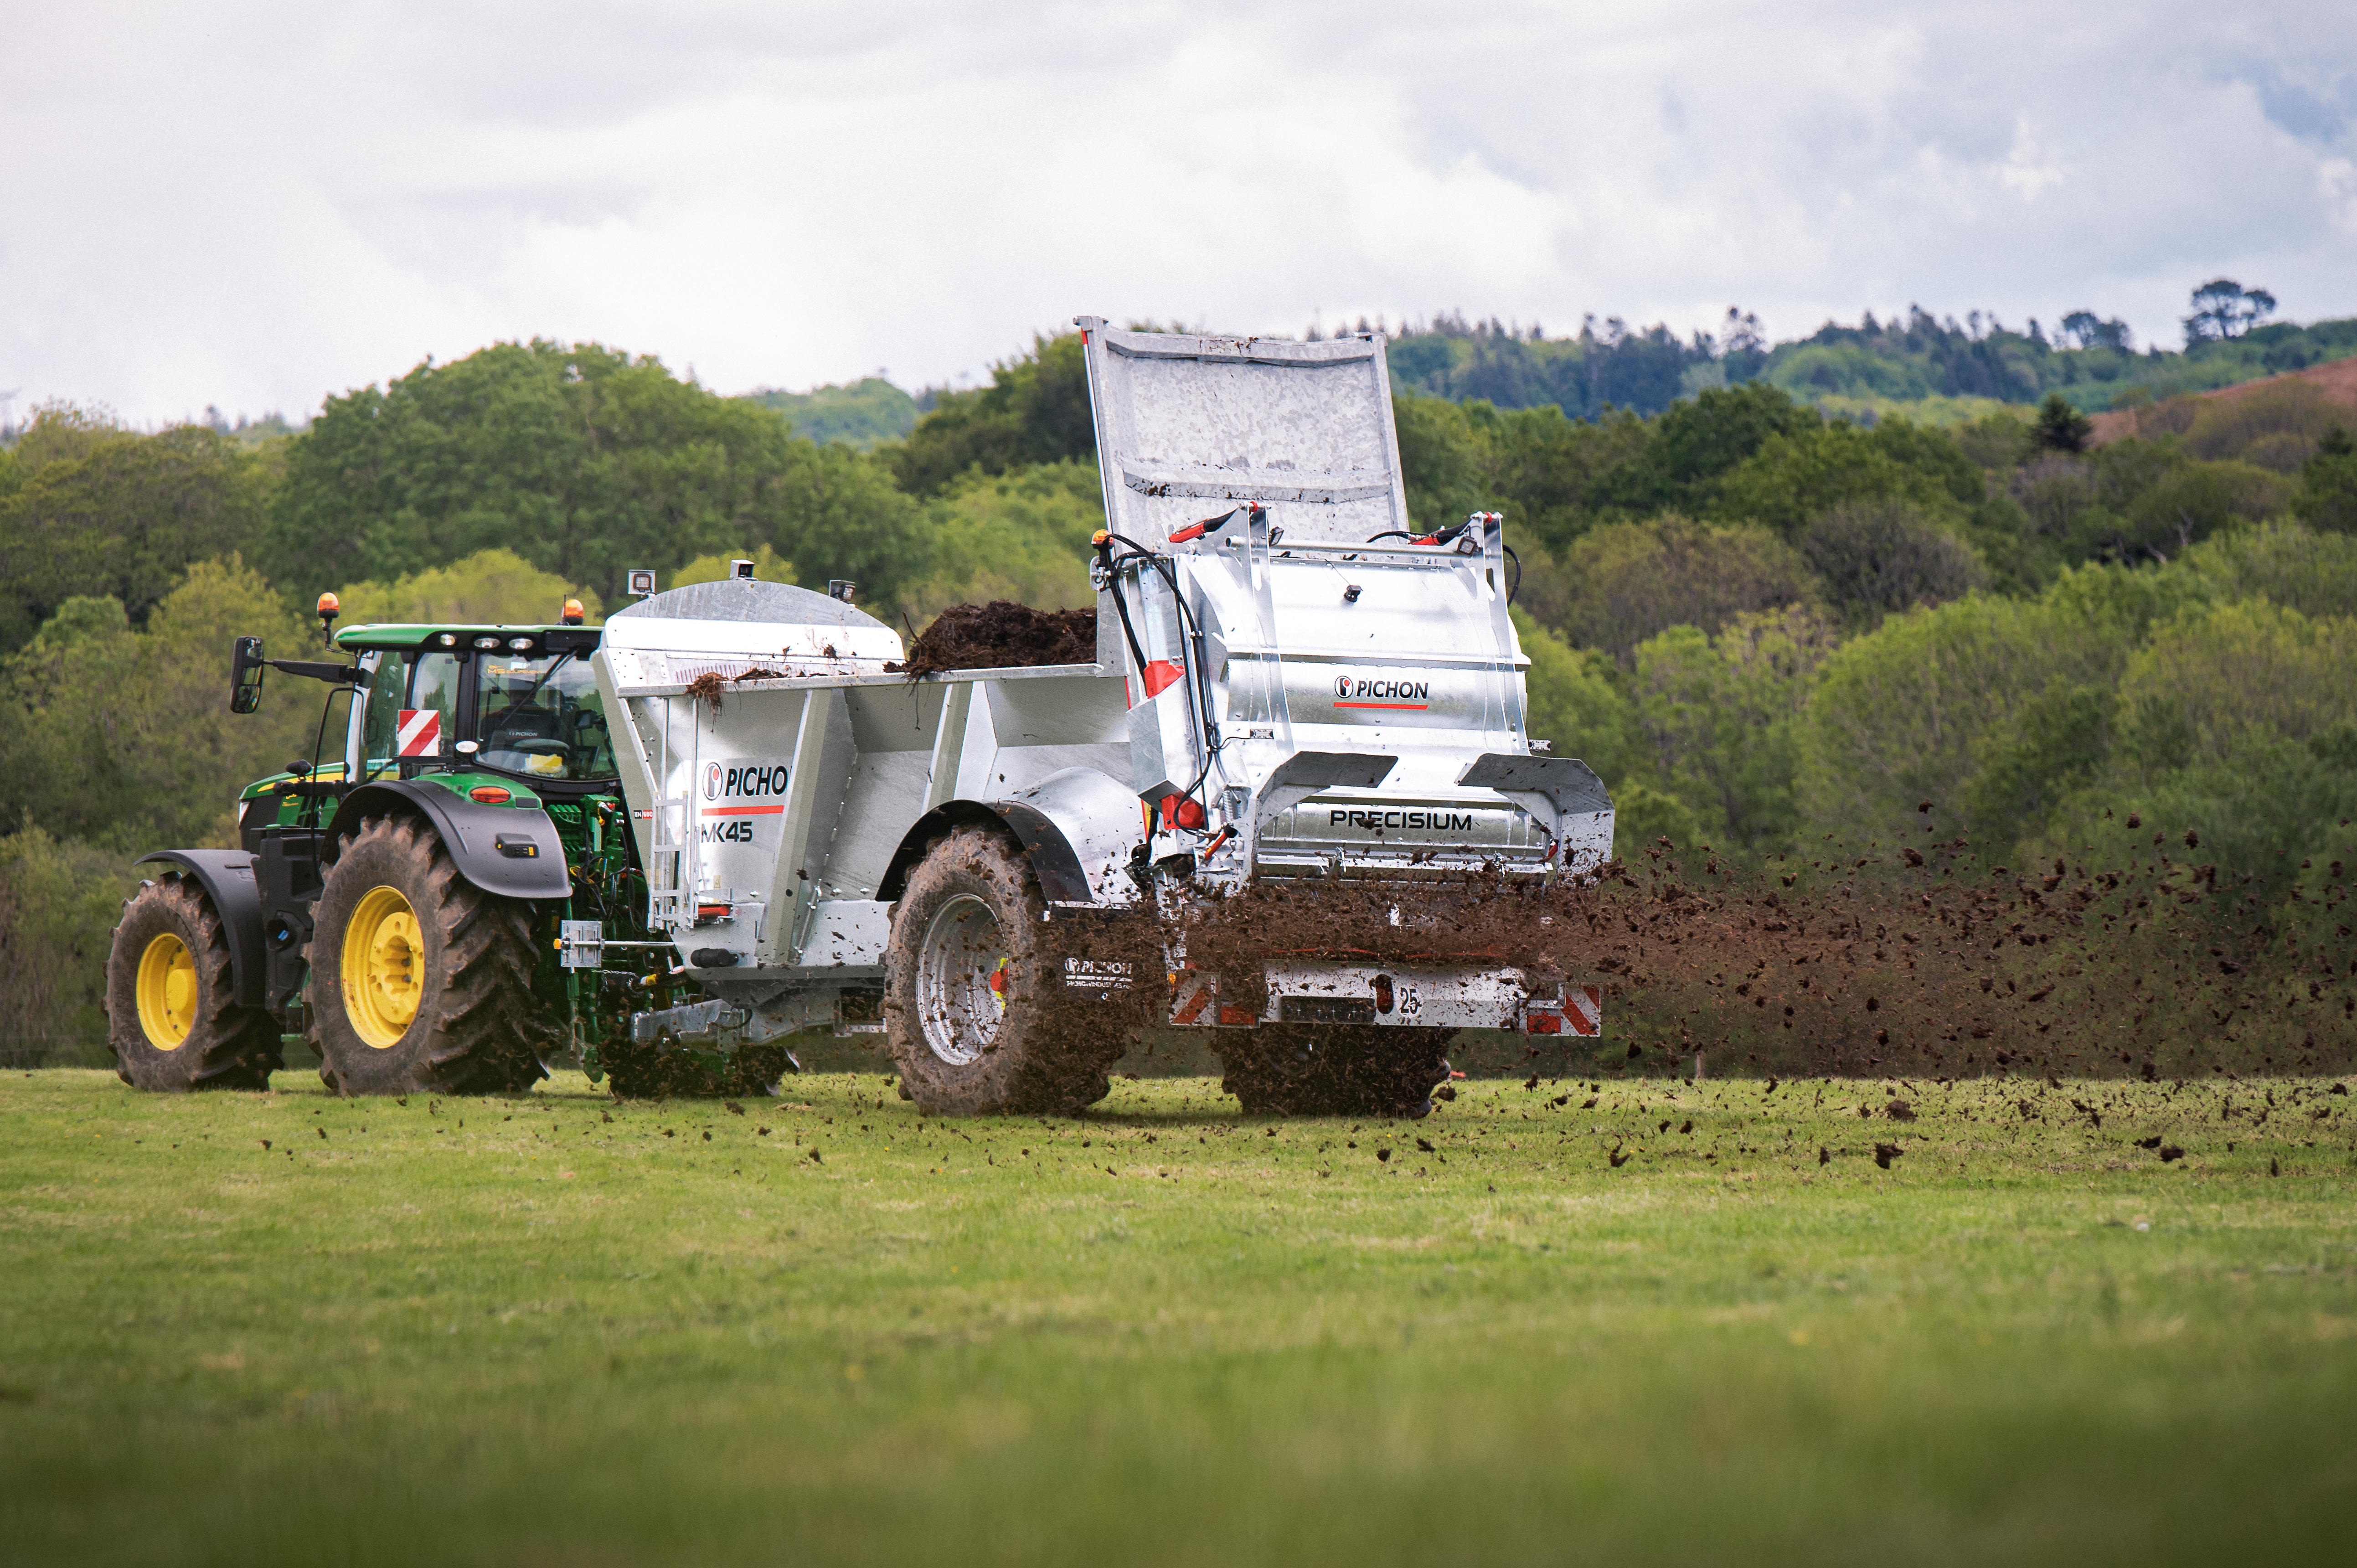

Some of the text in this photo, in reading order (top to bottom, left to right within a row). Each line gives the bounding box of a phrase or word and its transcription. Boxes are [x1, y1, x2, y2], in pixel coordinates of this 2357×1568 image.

[1356, 681, 1429, 699] PICHON
[725, 766, 792, 796] PICHO
[1330, 810, 1472, 830] PRECISIUM
[701, 821, 753, 842] MK45
[1399, 987, 1418, 1014] 25
